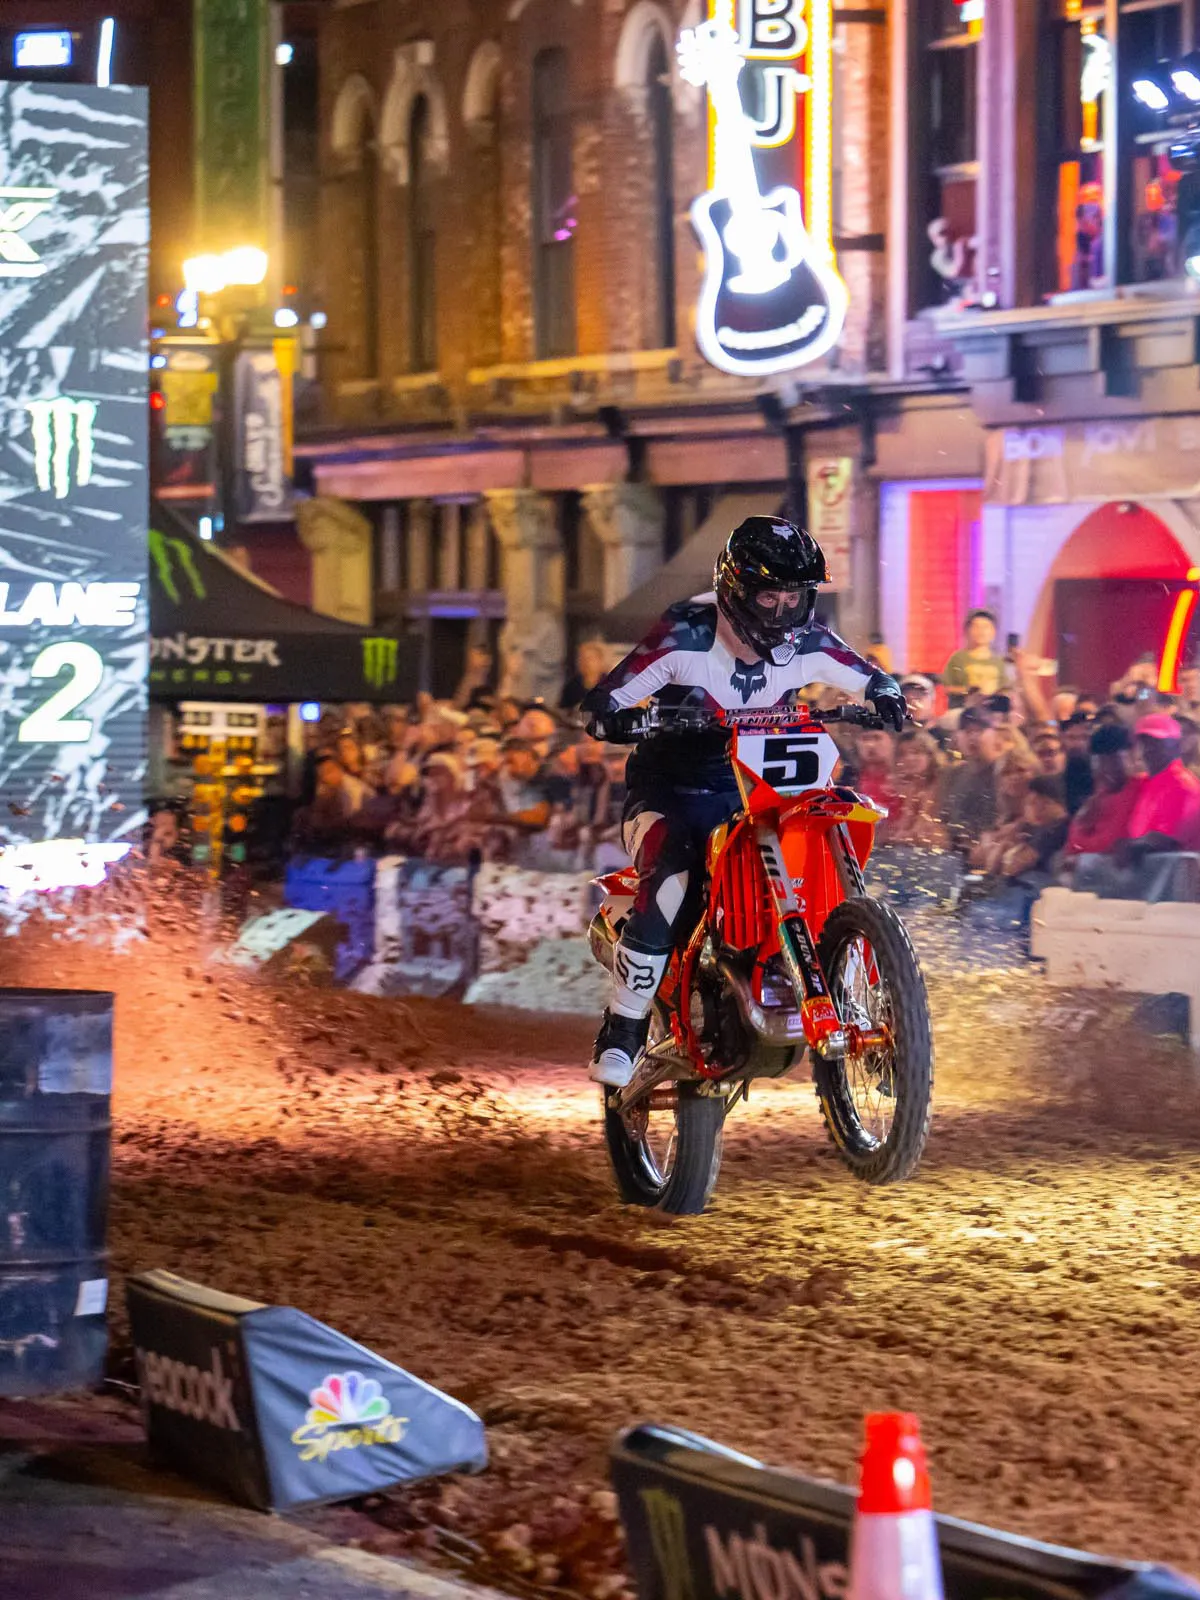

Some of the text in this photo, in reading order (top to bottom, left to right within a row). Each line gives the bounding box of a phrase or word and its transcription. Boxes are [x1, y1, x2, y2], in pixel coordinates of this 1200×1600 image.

[0, 582, 141, 626] LANE
[18, 641, 104, 742] 2
[762, 737, 819, 787] 5
[796, 934, 824, 994] DUNOP
[292, 1414, 410, 1462] Sports
